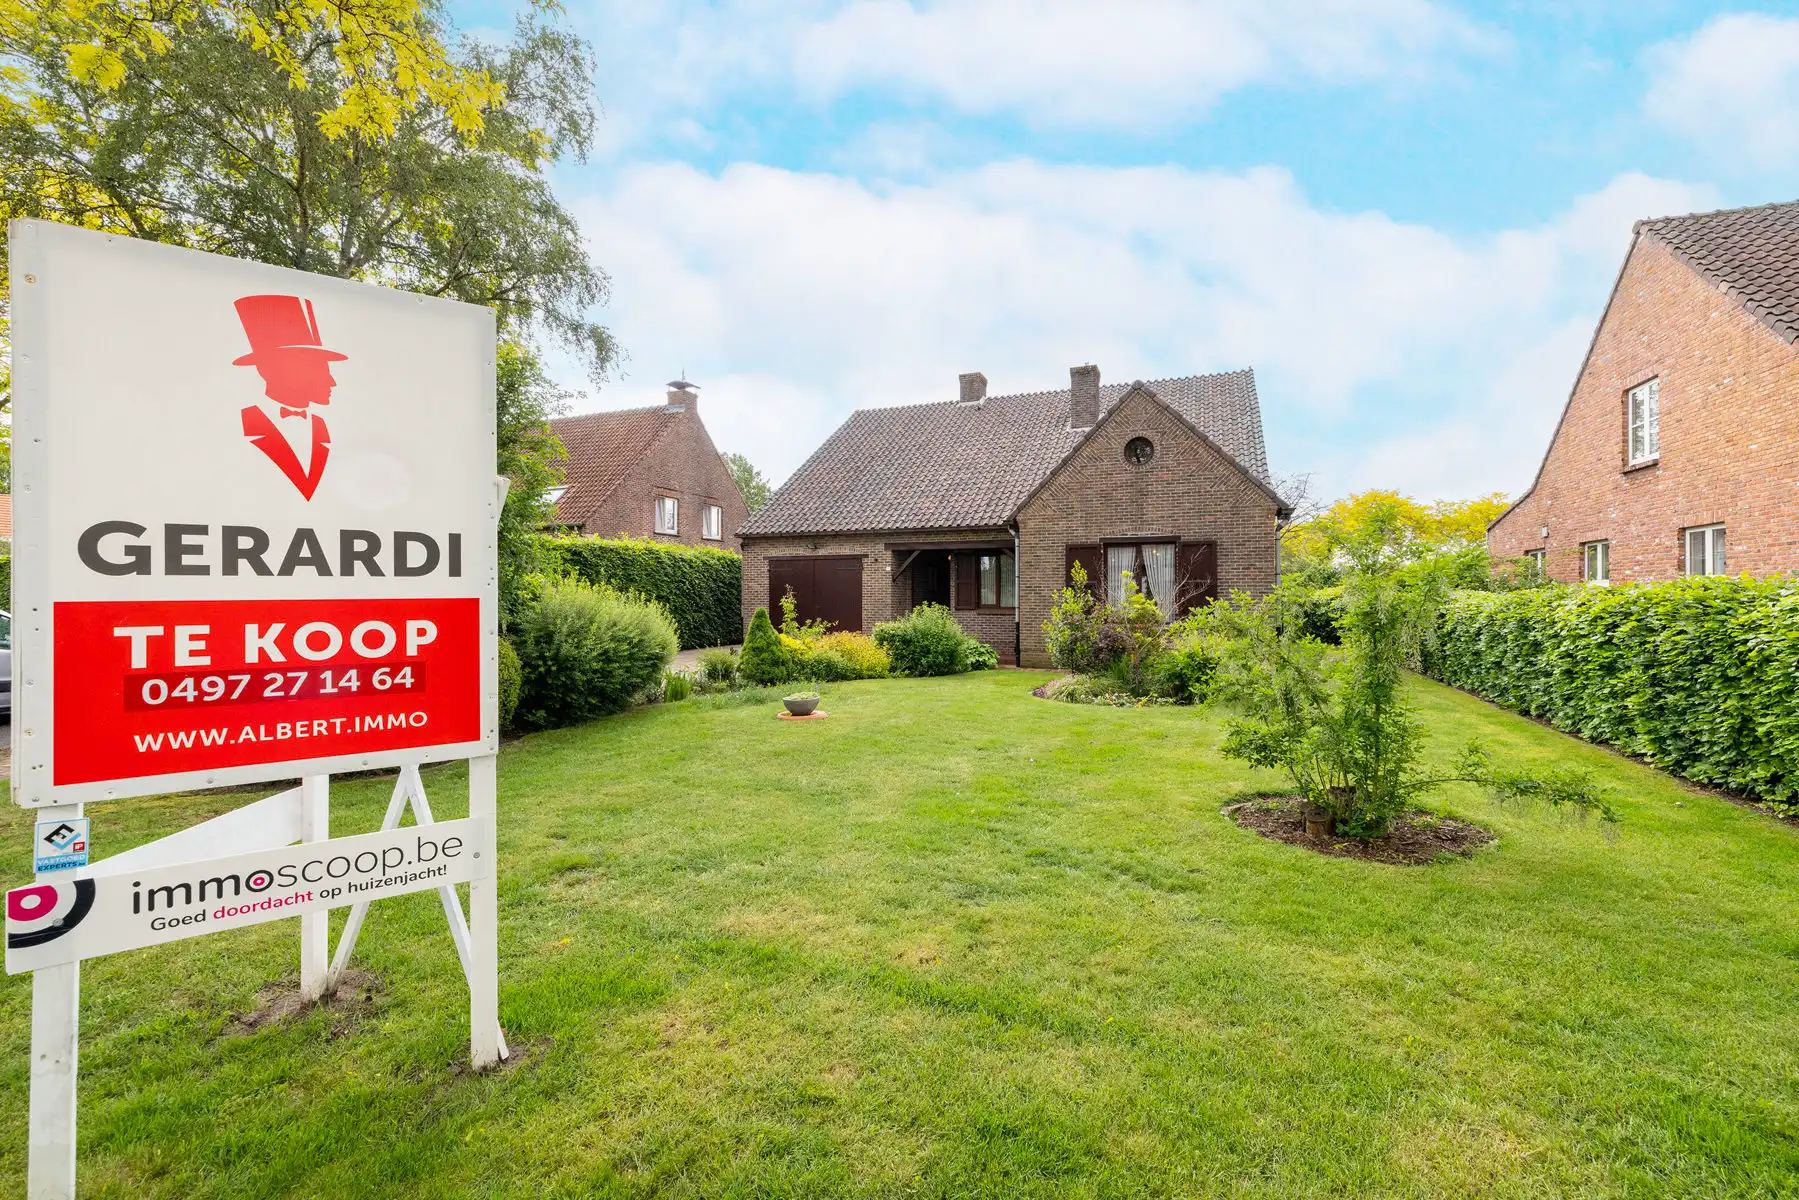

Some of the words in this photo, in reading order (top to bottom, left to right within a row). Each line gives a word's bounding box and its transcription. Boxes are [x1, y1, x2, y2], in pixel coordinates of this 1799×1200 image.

[77, 520, 462, 578] GERARDI
[113, 624, 211, 669] TE
[244, 619, 438, 664] KOOP
[141, 674, 251, 705] 0497
[263, 671, 308, 698] 27
[319, 668, 361, 694] 14
[371, 666, 415, 690] 64
[133, 711, 428, 753] WWW.ALBERT.IMMO
[132, 836, 463, 914] immoscoop.be
[150, 909, 206, 931] Goed
[213, 890, 314, 920] doordacht
[319, 886, 342, 899] op
[348, 864, 448, 893] huizenjacht!
